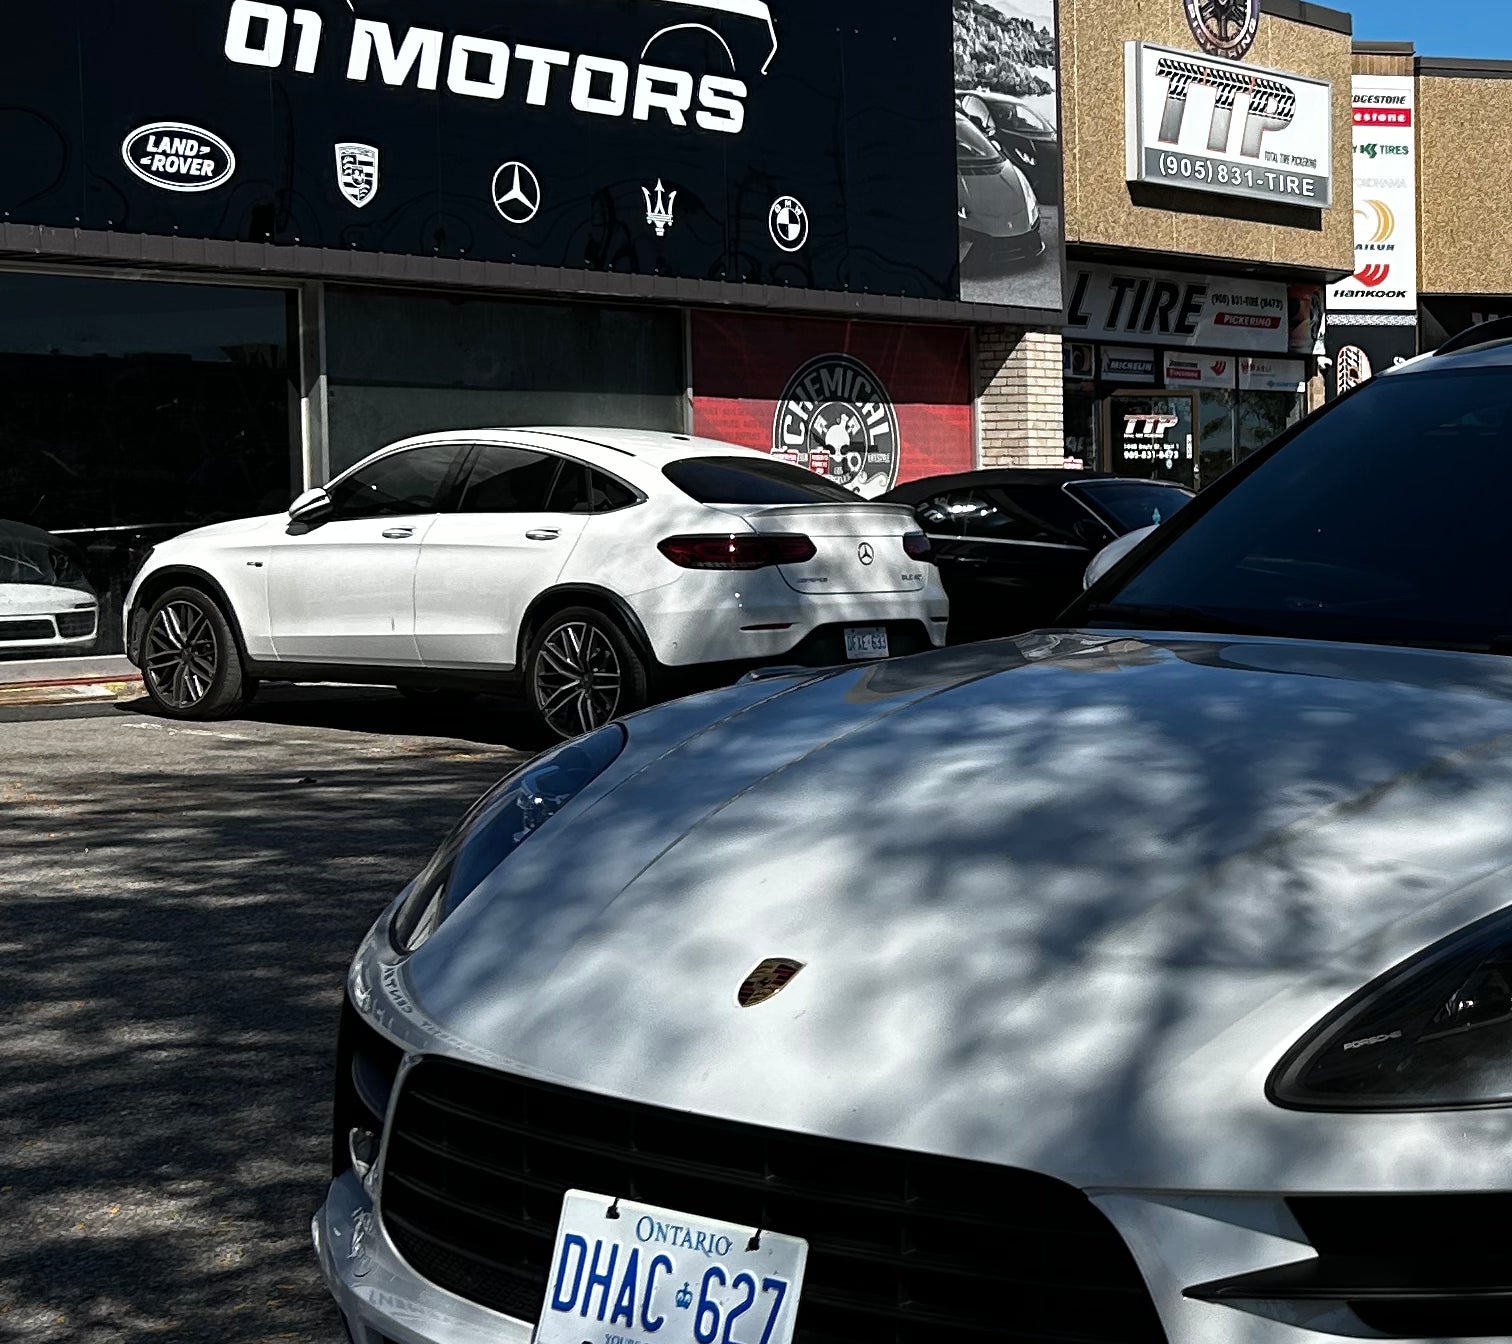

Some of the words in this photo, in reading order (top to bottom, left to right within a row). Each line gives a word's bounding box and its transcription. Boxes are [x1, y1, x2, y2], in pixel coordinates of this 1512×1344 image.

[346, 17, 748, 134] MOTORS
[1155, 56, 1296, 159] TTP
[1352, 94, 1407, 105] DGESTONE
[145, 135, 198, 157] LAND
[1379, 144, 1410, 156] TIRES
[150, 153, 215, 178] ROVER
[774, 199, 803, 216] BMW
[1354, 243, 1395, 252] AILUN
[1103, 274, 1211, 338] TIRE
[1223, 314, 1272, 328] PICKERING
[1109, 360, 1153, 372] MICHELIN
[782, 366, 890, 446] CHEMICAL
[1123, 413, 1179, 434] TTP
[635, 1214, 734, 1258] ONTARIO
[550, 1232, 674, 1333] DHAC
